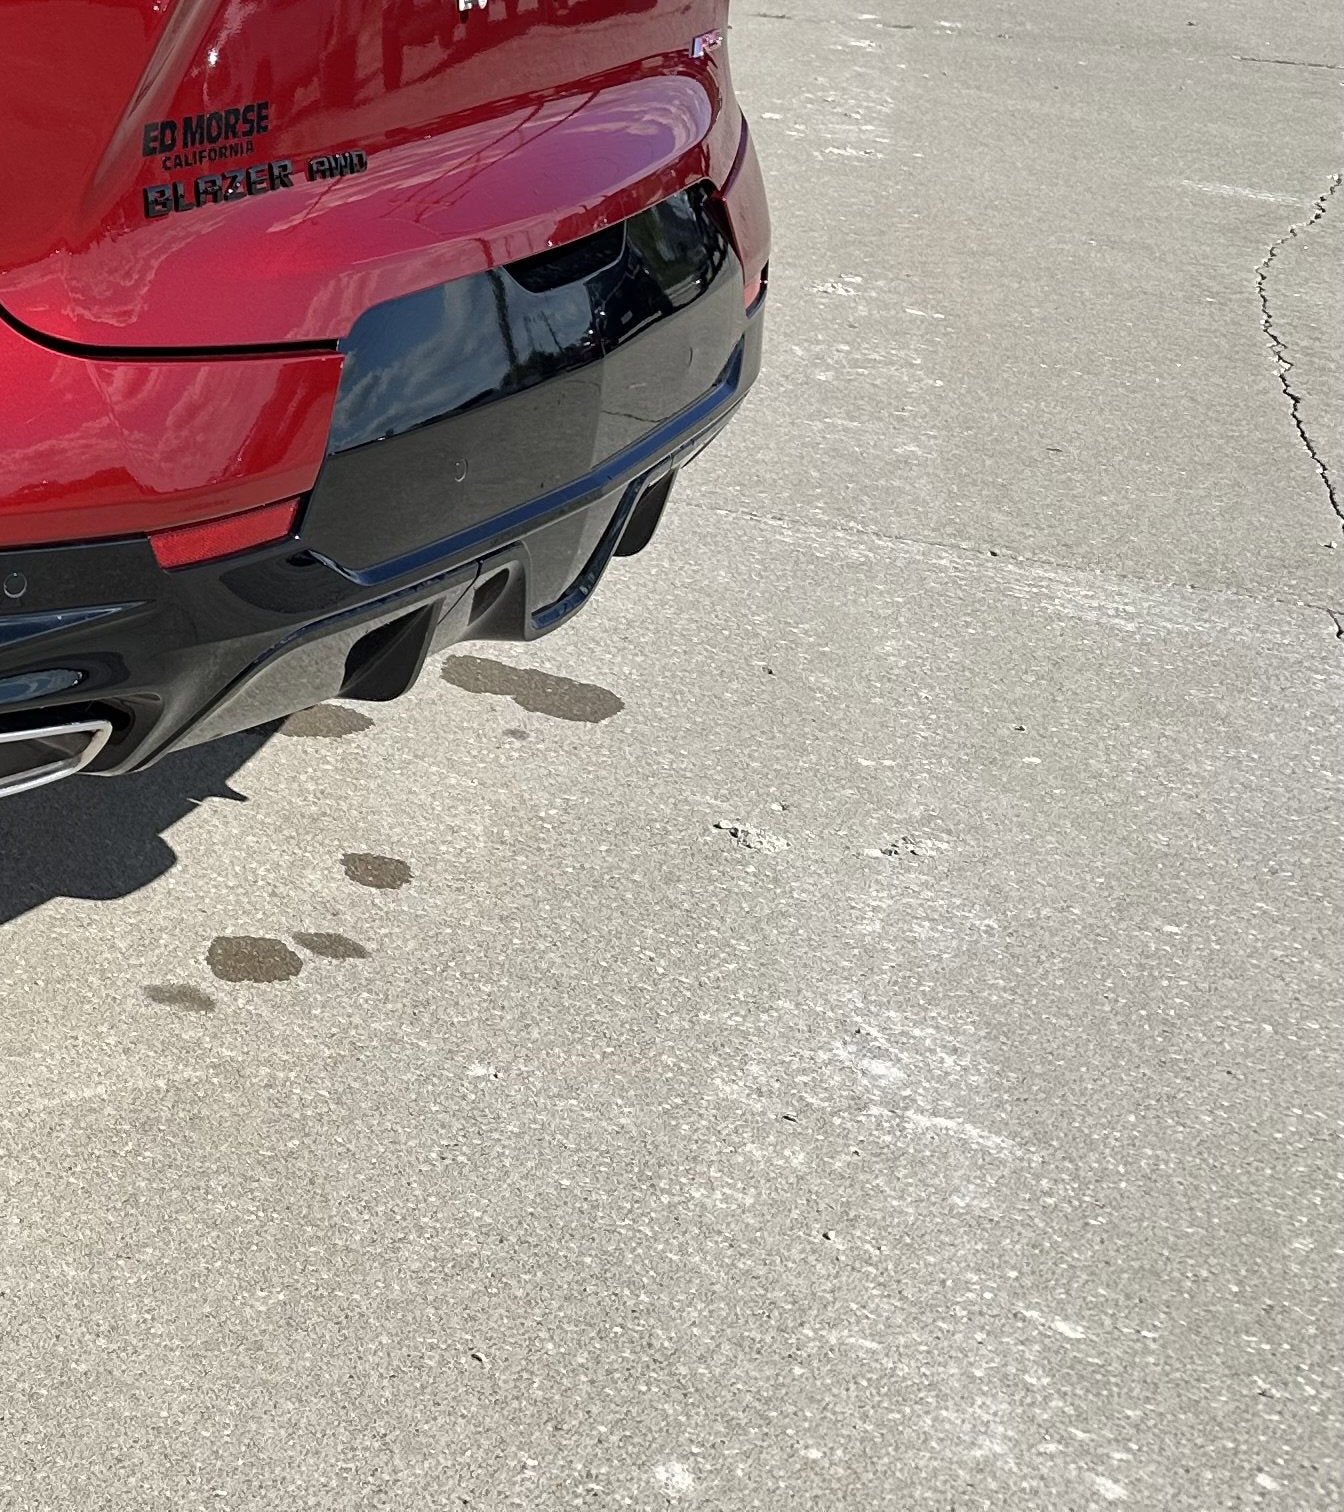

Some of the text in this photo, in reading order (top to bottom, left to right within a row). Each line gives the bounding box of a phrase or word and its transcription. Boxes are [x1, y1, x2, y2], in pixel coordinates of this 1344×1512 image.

[142, 101, 269, 157] ED MORSE
[162, 140, 255, 171] CALIFORNIA
[144, 150, 368, 219] BLAZER AWD
